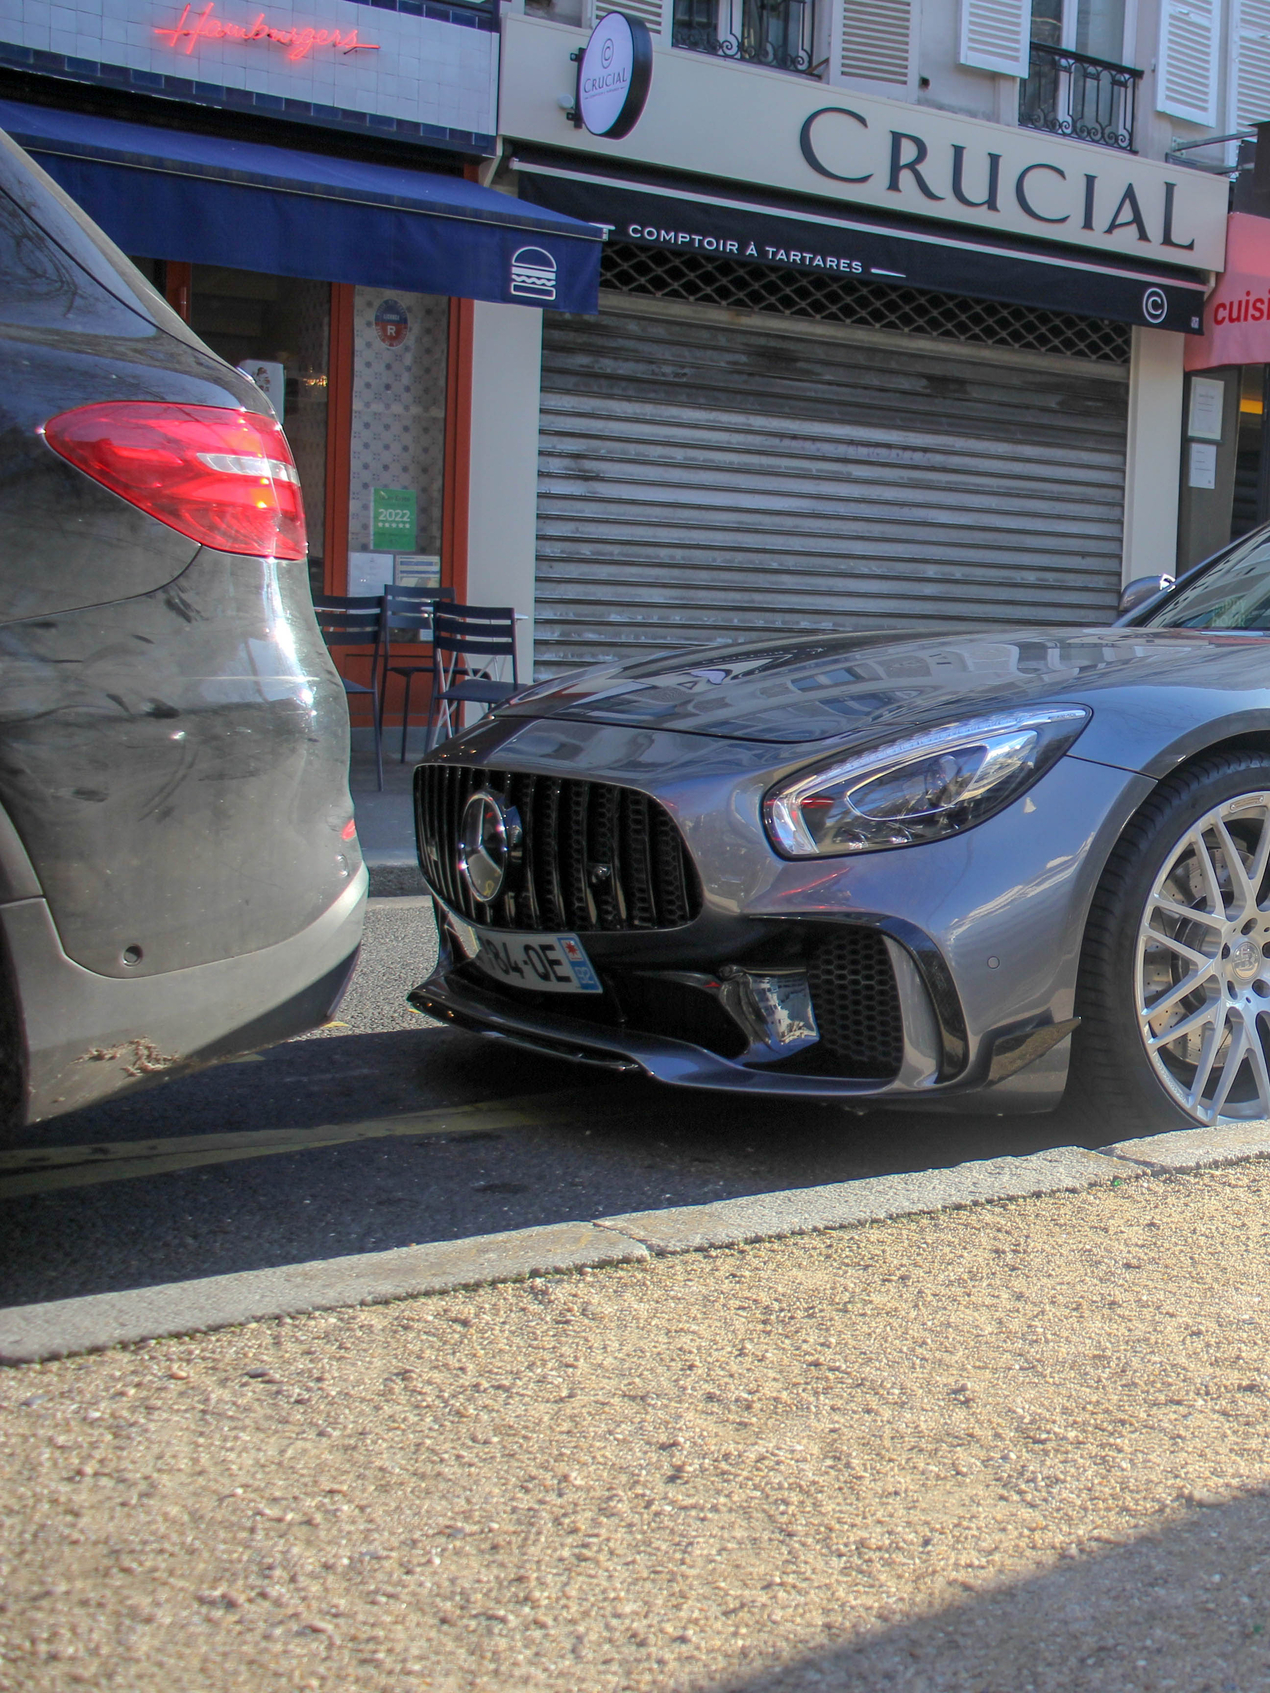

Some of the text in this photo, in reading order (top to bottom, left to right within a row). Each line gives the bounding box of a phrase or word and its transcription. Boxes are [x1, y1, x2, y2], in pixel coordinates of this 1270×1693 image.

[154, 2, 381, 60] Hamburgers
[583, 67, 628, 94] CRUCIAL
[799, 105, 1196, 252] CRUCIAL
[628, 224, 864, 274] COMPTOIR À TARTARES
[387, 325, 397, 337] R
[378, 509, 411, 522] 2022
